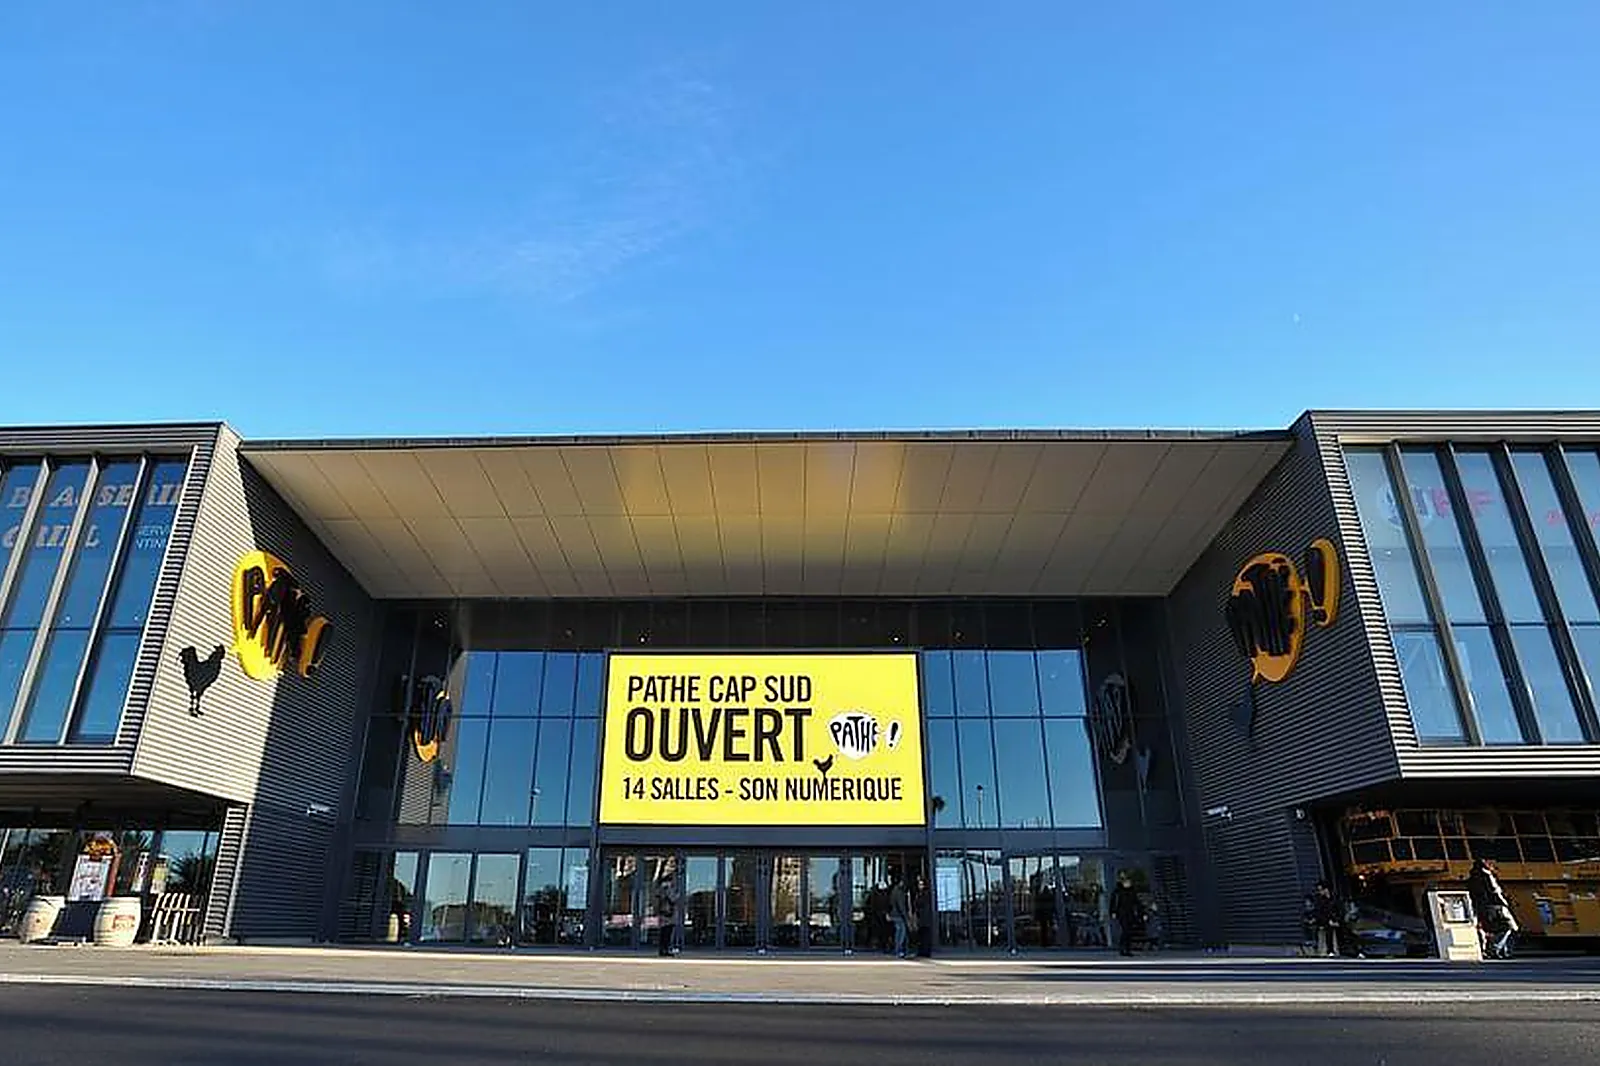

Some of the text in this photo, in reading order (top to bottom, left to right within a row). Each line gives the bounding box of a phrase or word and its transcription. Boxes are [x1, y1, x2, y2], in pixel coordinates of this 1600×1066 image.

[627, 674, 812, 704] PATHE CAP SUD
[624, 706, 813, 763] OUVERT
[622, 777, 645, 801] 14
[650, 777, 719, 801] SALLES
[739, 777, 779, 801] SON
[785, 776, 905, 802] NUMERIQUE
